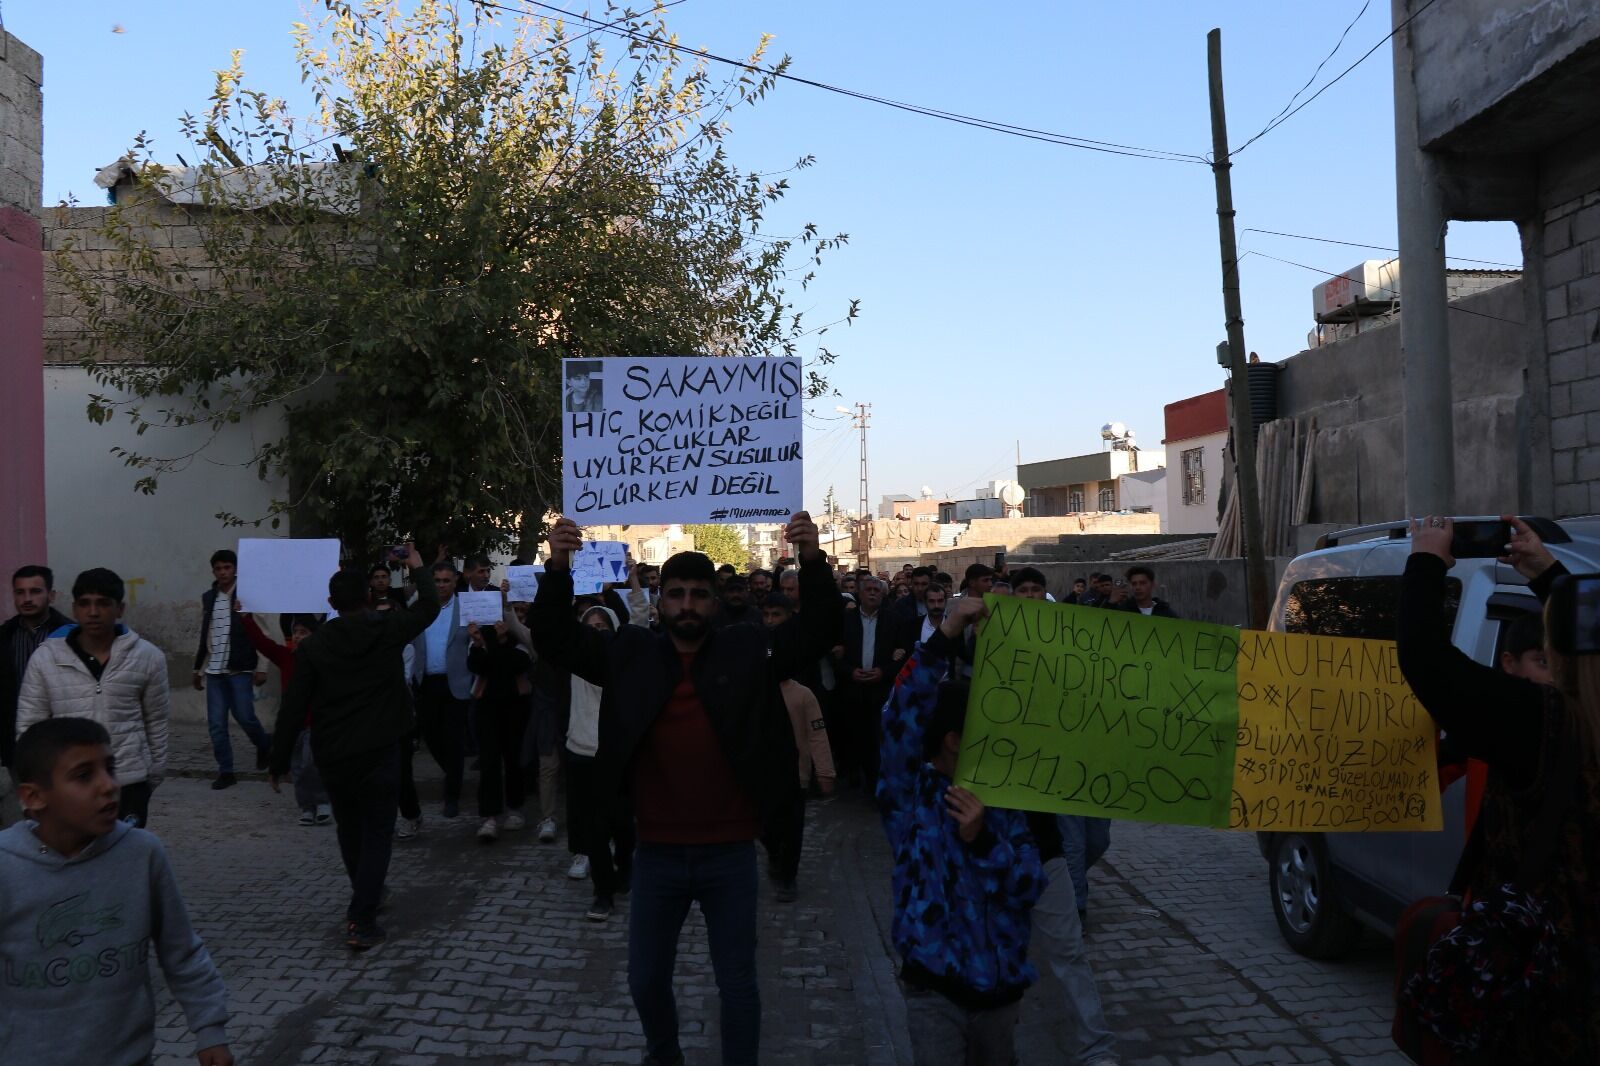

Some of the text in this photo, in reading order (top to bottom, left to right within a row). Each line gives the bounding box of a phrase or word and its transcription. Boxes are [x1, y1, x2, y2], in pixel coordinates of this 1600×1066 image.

[573, 441, 803, 479] UYURKEN SUSULUR
[617, 425, 761, 457] ÇOCUKLAR
[575, 471, 780, 513] ÖLÜRKEN DEĞİL
[1250, 634, 1406, 685] MUHAME
